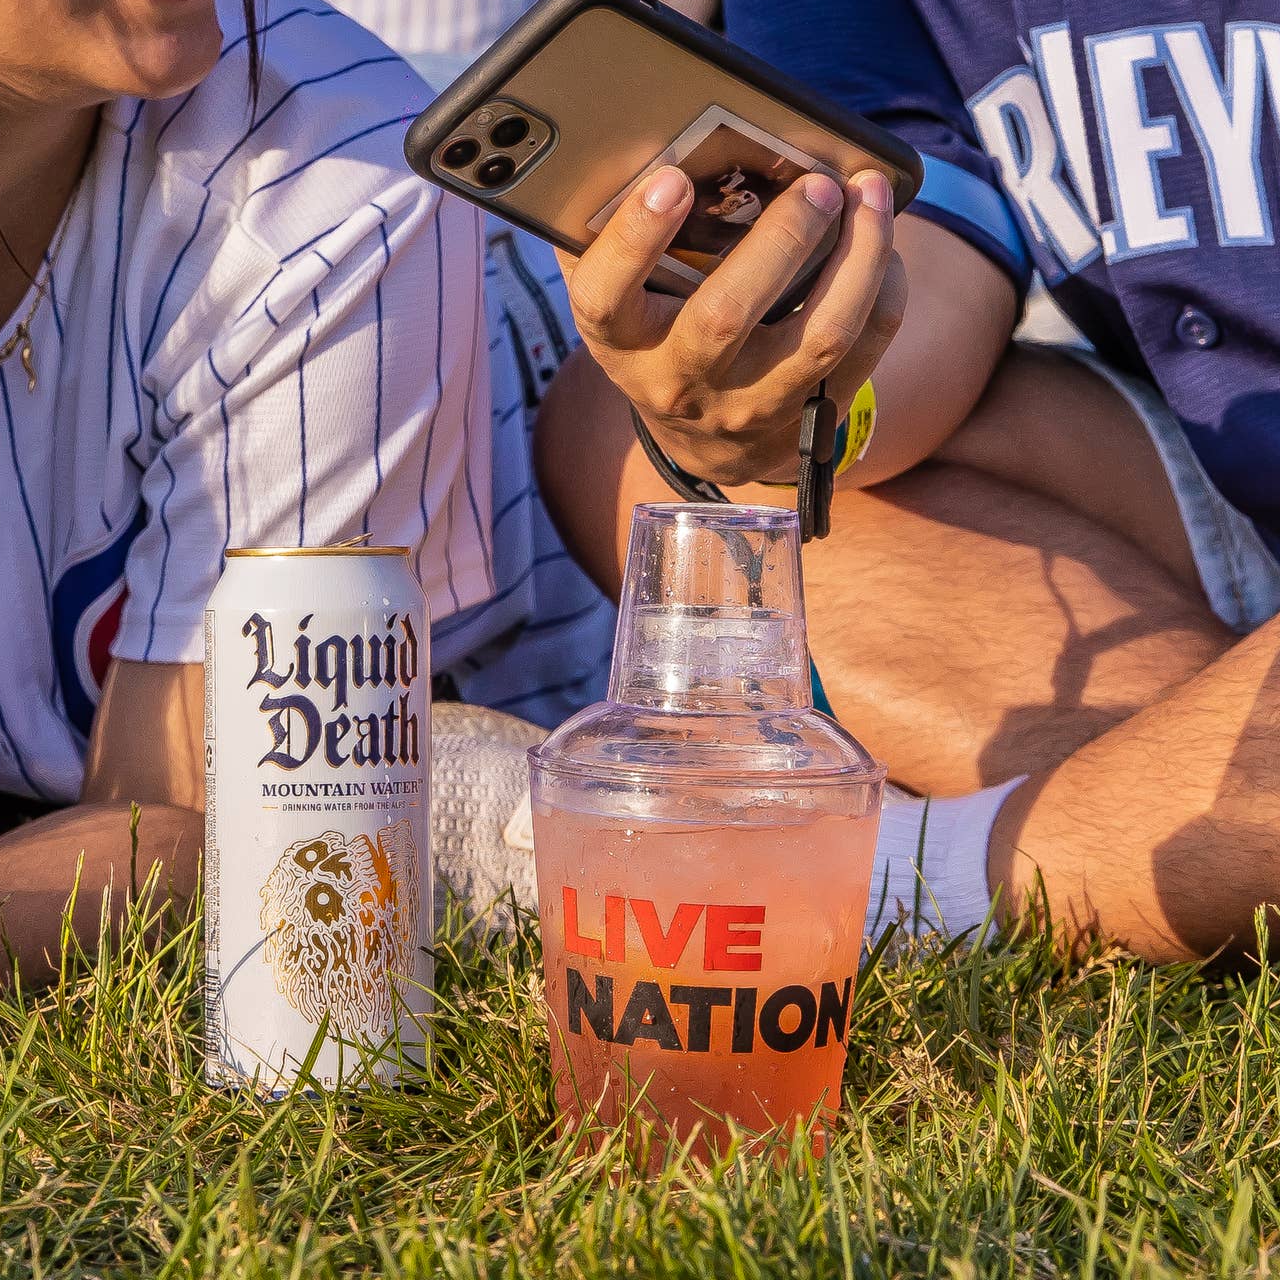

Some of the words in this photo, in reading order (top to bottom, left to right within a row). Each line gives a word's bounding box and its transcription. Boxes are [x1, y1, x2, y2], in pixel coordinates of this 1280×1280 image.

[241, 612, 418, 712] Liquid
[257, 691, 420, 771] Death
[262, 783, 365, 797] MOUNTAIN
[282, 803, 322, 812] DRINKING
[324, 802, 352, 811] WATER
[354, 802, 375, 811] FROM
[377, 801, 390, 810] THE
[391, 800, 407, 809] ALPS
[562, 886, 766, 972] LIVE
[566, 967, 853, 1054] NATION
